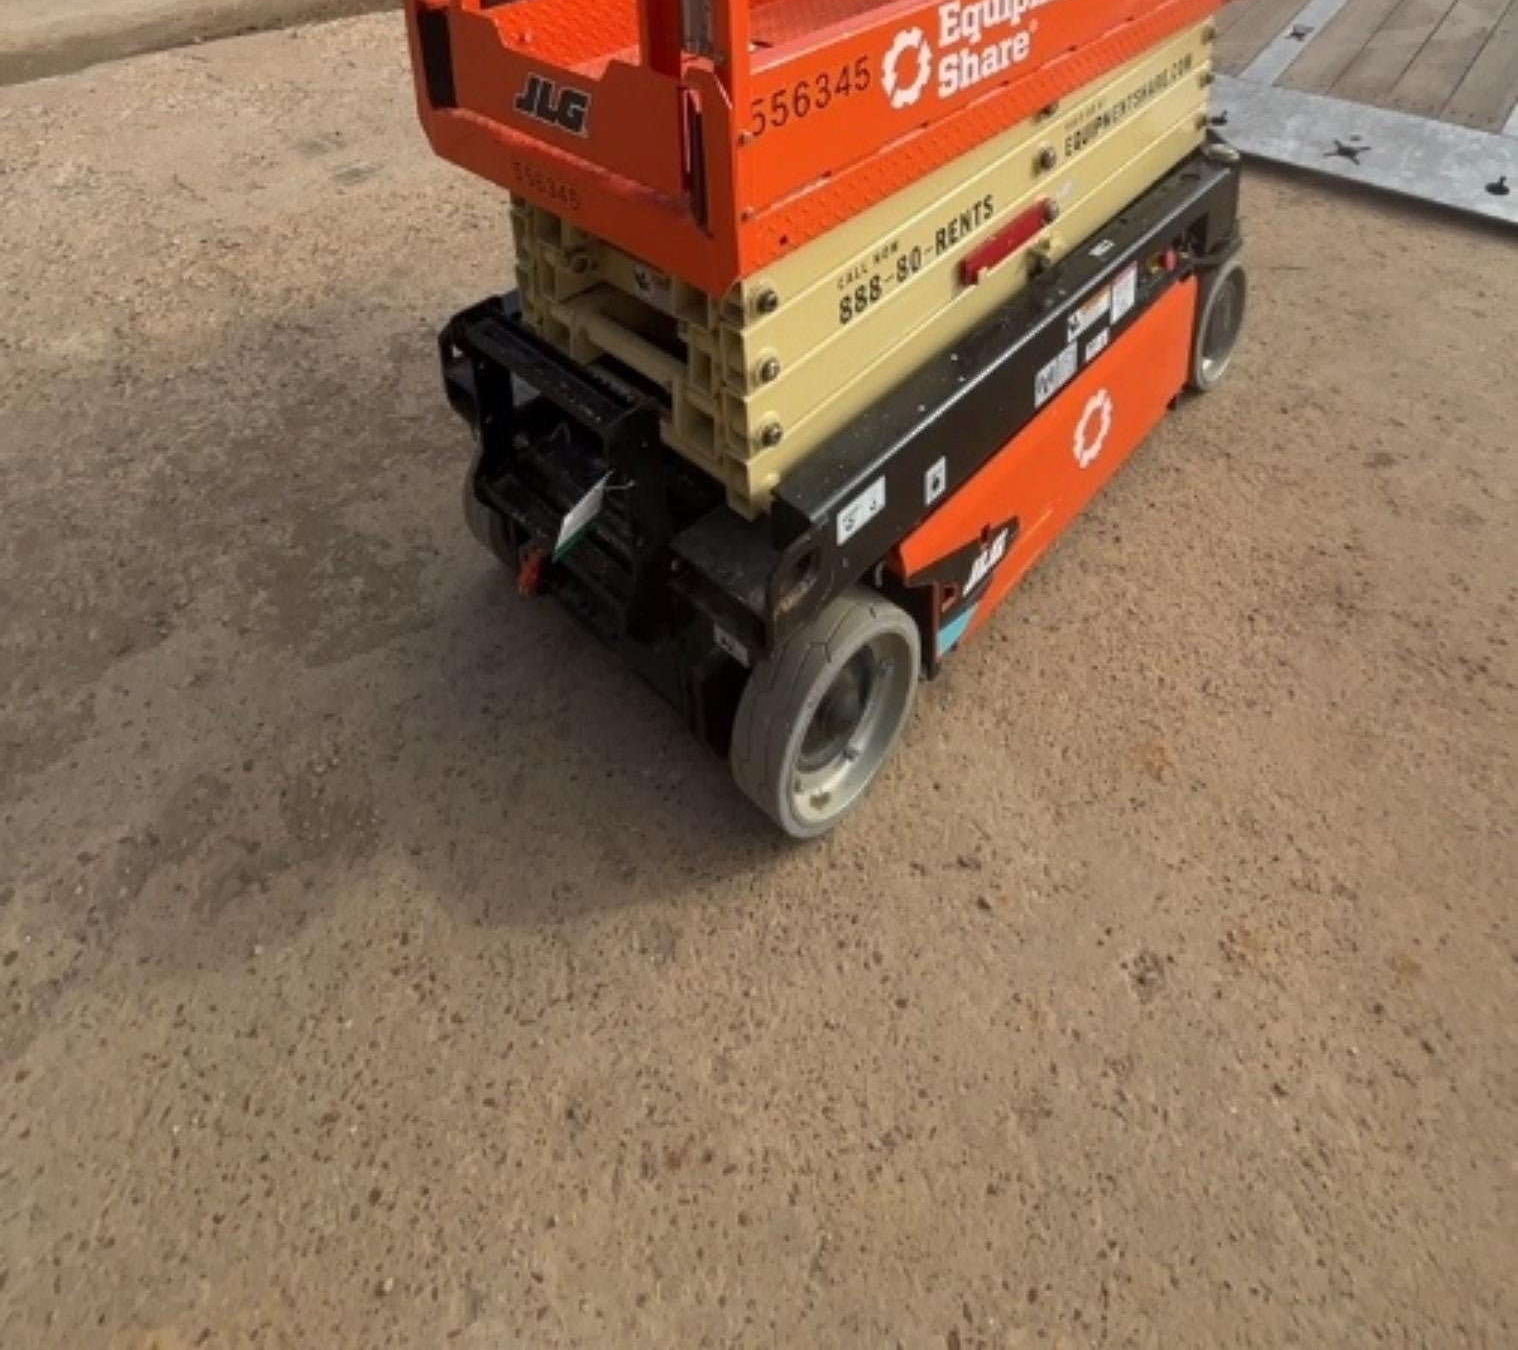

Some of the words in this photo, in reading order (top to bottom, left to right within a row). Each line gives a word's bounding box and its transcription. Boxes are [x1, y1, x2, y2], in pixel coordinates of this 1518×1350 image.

[751, 55, 871, 137] 556345
[938, 31, 1030, 98] Share
[513, 72, 591, 138] JLG
[837, 263, 868, 290] CALL
[873, 241, 899, 264] NOW
[839, 194, 994, 325] 888-80-RENTS
